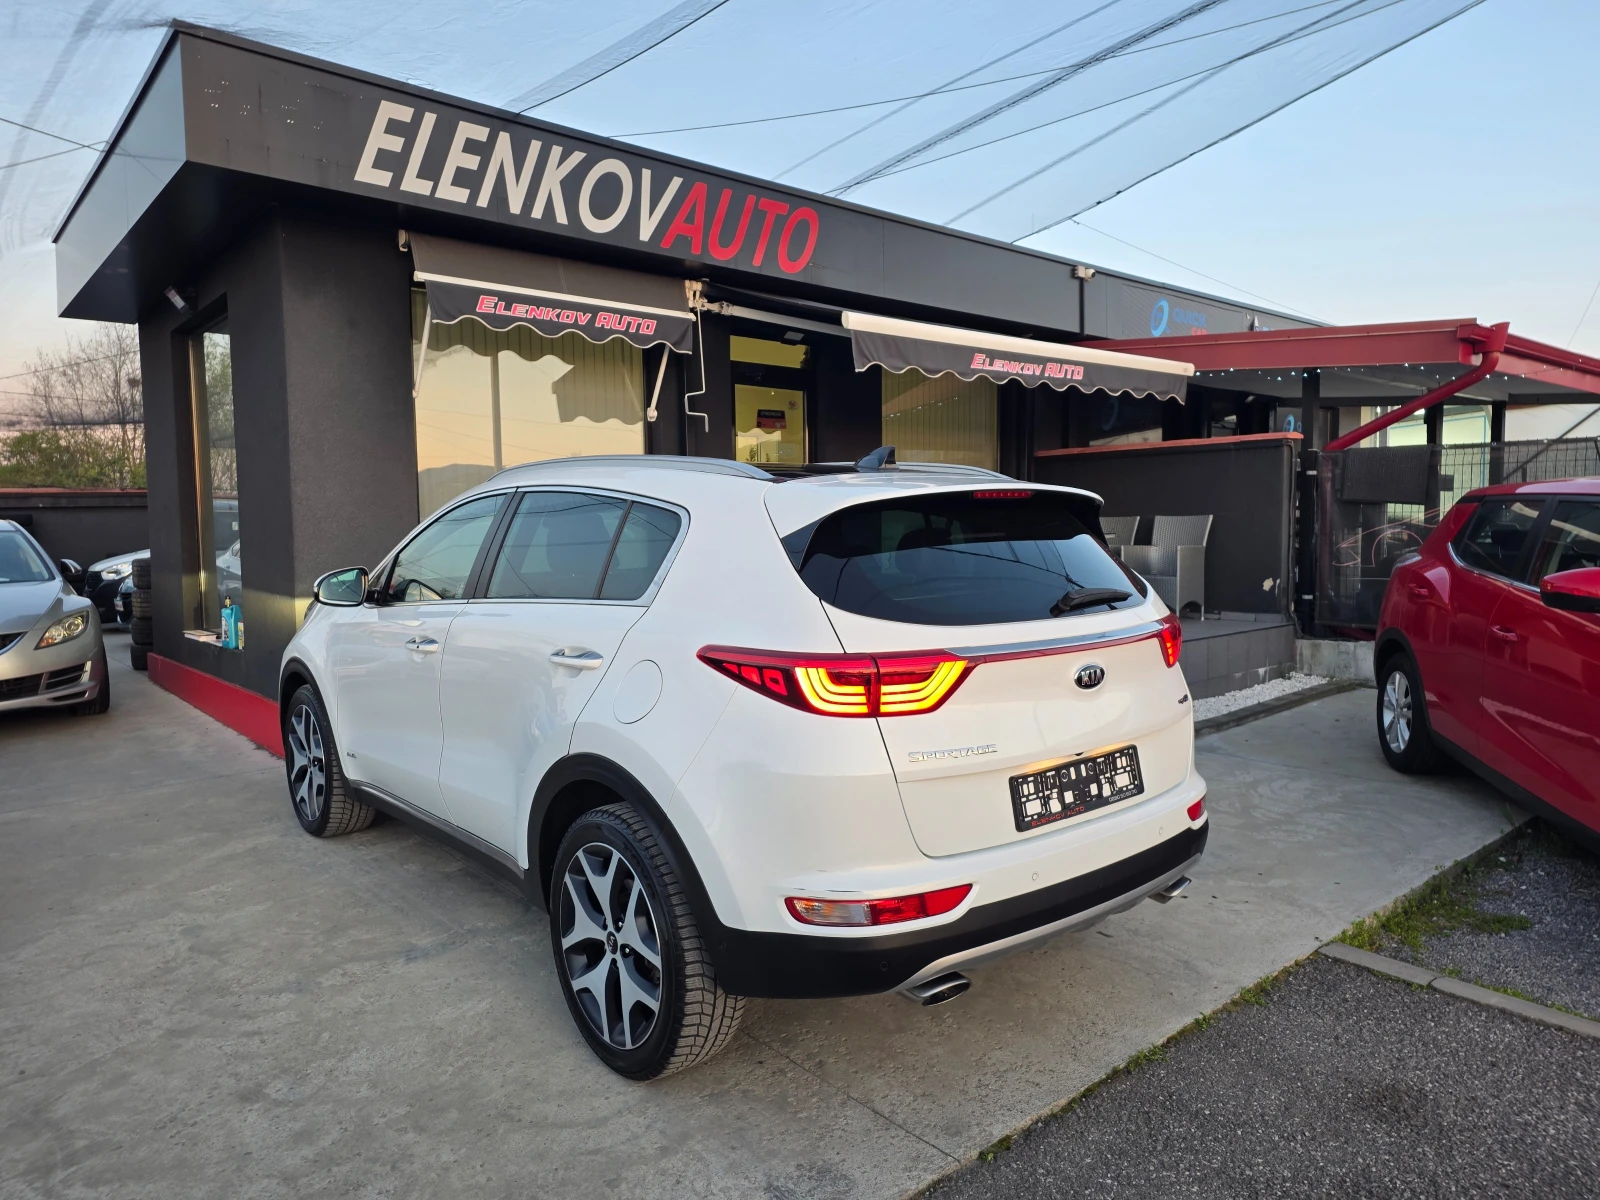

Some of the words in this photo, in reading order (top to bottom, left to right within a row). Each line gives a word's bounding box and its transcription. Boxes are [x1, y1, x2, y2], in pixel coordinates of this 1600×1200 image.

[476, 295, 592, 325] ELENKOV
[595, 311, 657, 335] AUTO
[1173, 307, 1207, 327] QUICK
[971, 353, 1043, 375] ELENKOV
[1045, 362, 1084, 380] AUTO
[1081, 668, 1103, 686] KIA
[908, 743, 998, 762] SPORTAGE
[1067, 806, 1085, 816] AUTO
